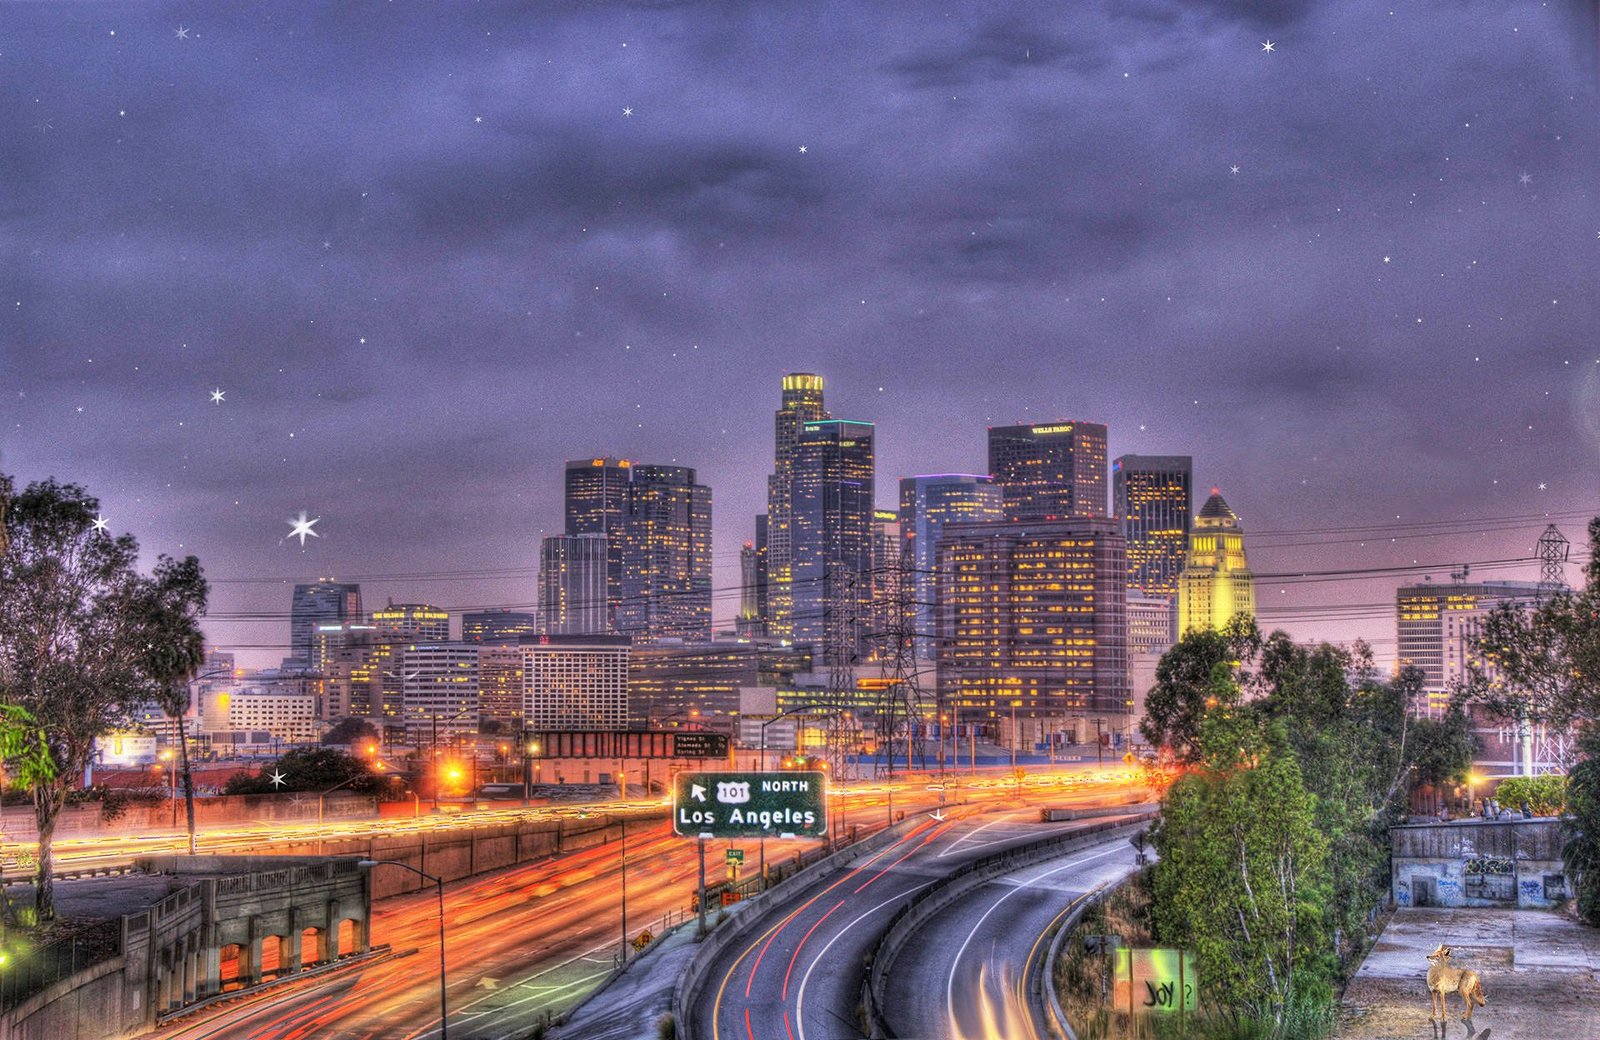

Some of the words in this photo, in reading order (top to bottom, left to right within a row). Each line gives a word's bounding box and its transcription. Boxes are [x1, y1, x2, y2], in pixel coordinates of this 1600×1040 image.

[723, 788, 745, 798] 101
[762, 781, 809, 792] NORTH
[680, 808, 715, 824] Los
[729, 808, 815, 830] Angeles
